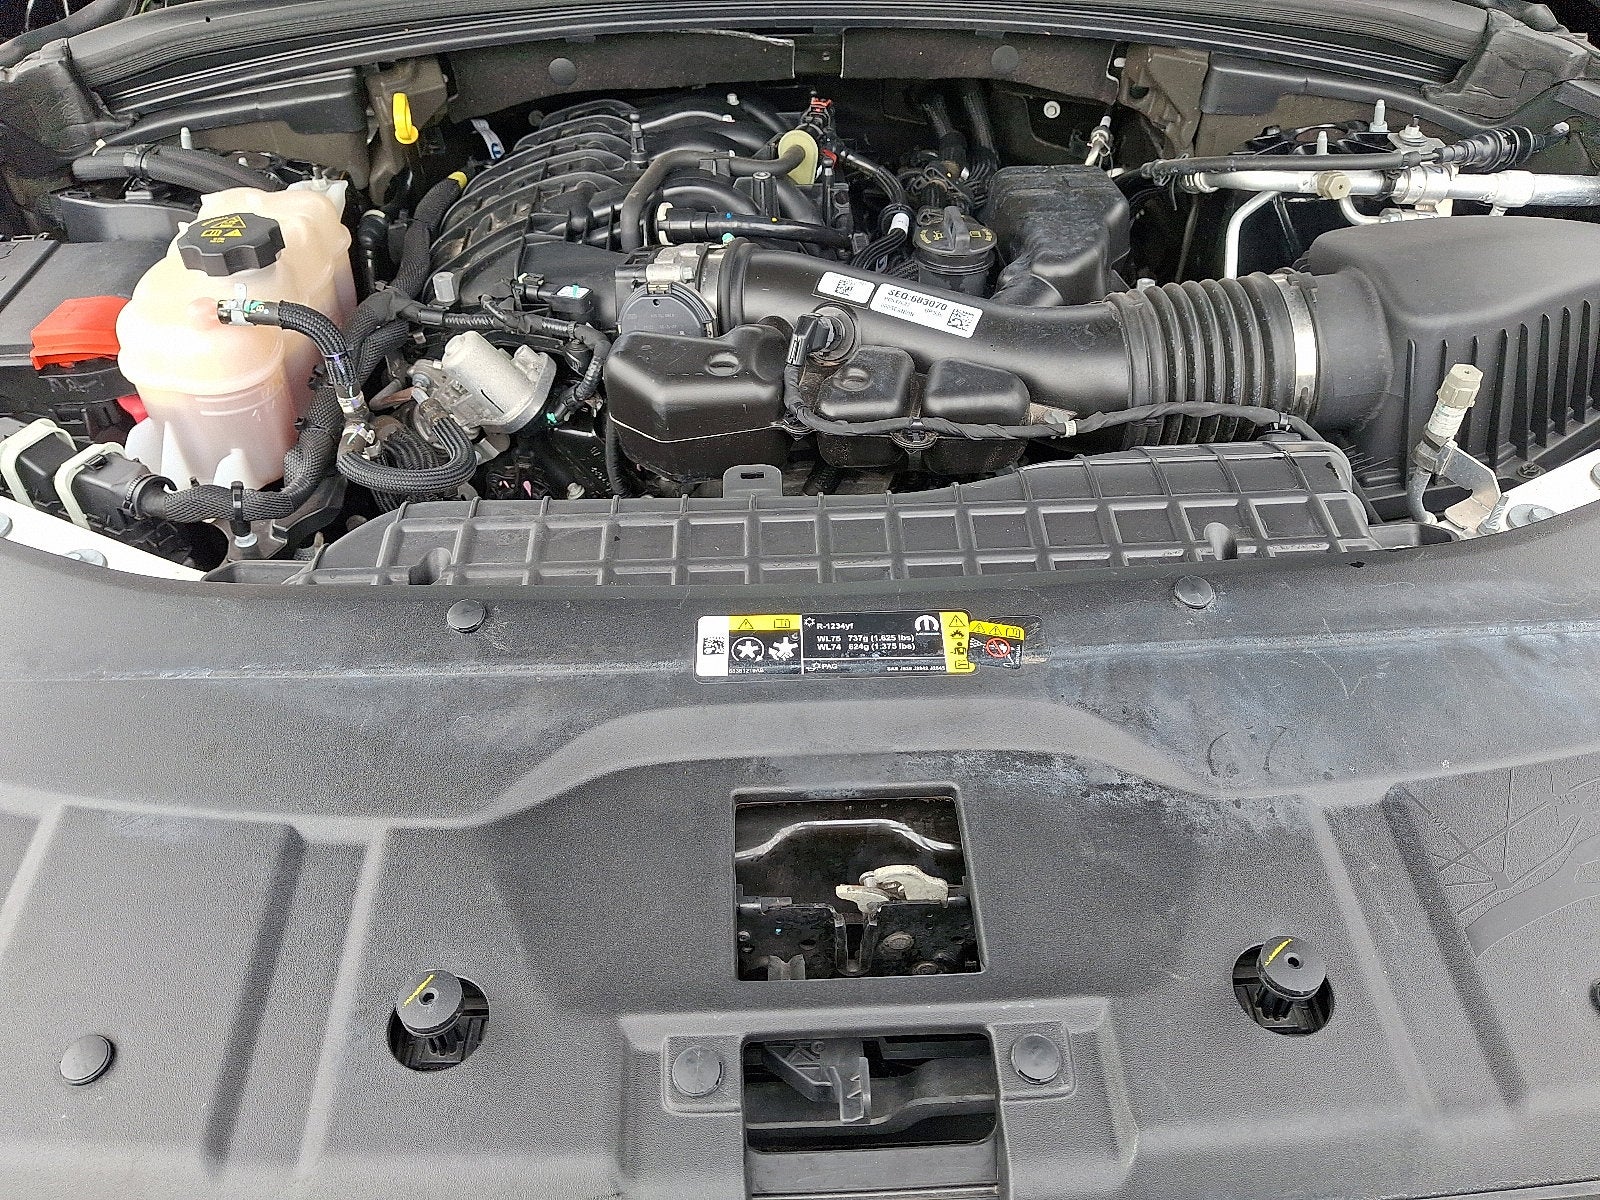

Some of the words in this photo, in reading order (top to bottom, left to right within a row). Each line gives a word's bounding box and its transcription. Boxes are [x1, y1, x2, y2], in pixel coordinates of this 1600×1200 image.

[887, 289, 948, 311] SEQ:683070
[816, 622, 854, 631] R-1234yf
[847, 634, 869, 643] 737g
[870, 634, 897, 642] (1.625
[898, 634, 915, 643] lbs)
[816, 643, 842, 651] WL74
[848, 643, 870, 651] 624g
[871, 642, 898, 651] (1.375
[898, 642, 916, 651] lbs)
